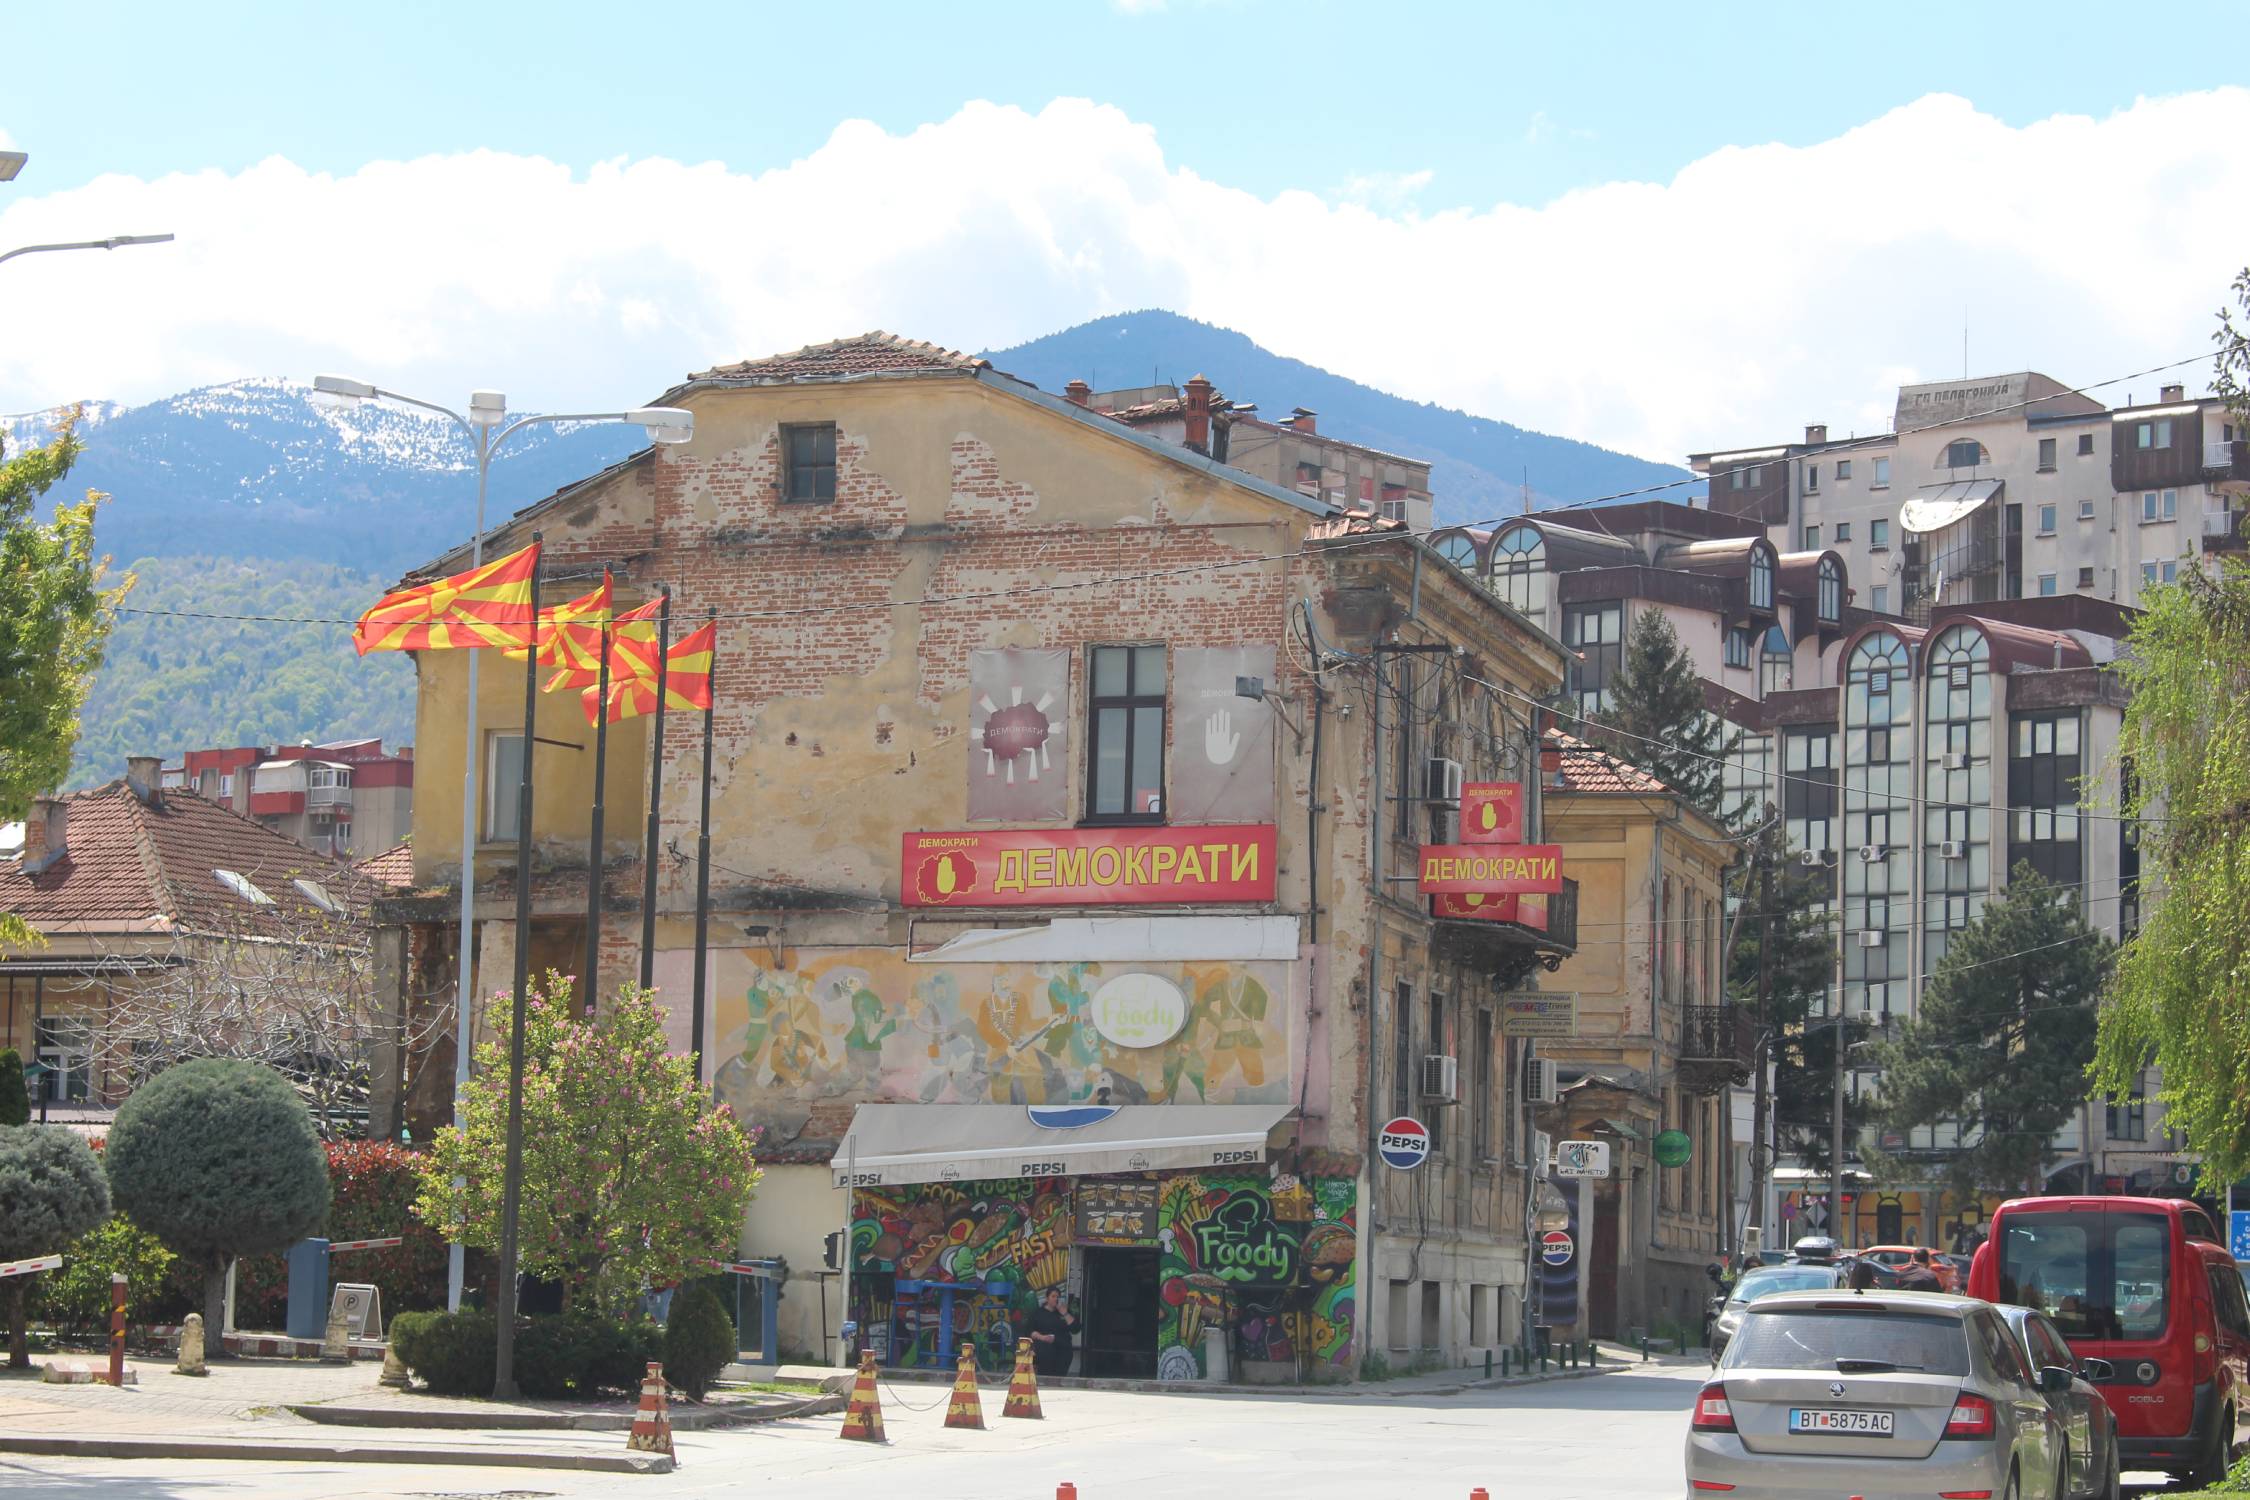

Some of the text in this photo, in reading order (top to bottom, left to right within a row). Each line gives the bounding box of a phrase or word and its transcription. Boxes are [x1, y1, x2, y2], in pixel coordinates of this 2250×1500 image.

[1934, 383, 2009, 402] ПЕЛАГОНИЈА
[990, 726, 1043, 737] ДЕМОКРАТИ
[1468, 788, 1513, 797] ДЕМОКРАТИ
[918, 836, 979, 849] ДЕМОКРАТИ
[993, 842, 1260, 894] ДЕМОКРАТИ
[1423, 857, 1556, 883] ДЕМОКРАТИ
[1102, 997, 1175, 1035] Foody
[1382, 1135, 1426, 1151] PEPSI
[1567, 1143, 1599, 1153] PIZZA
[1212, 1150, 1259, 1165] PEPSI
[1021, 1162, 1066, 1176] PEPSI
[840, 1173, 882, 1186] PEPSI
[1009, 1229, 1054, 1264] FAST
[1197, 1225, 1293, 1280] Foody
[1543, 1244, 1571, 1252] PEPSI
[1801, 1412, 1890, 1431] BT 5875 AC
